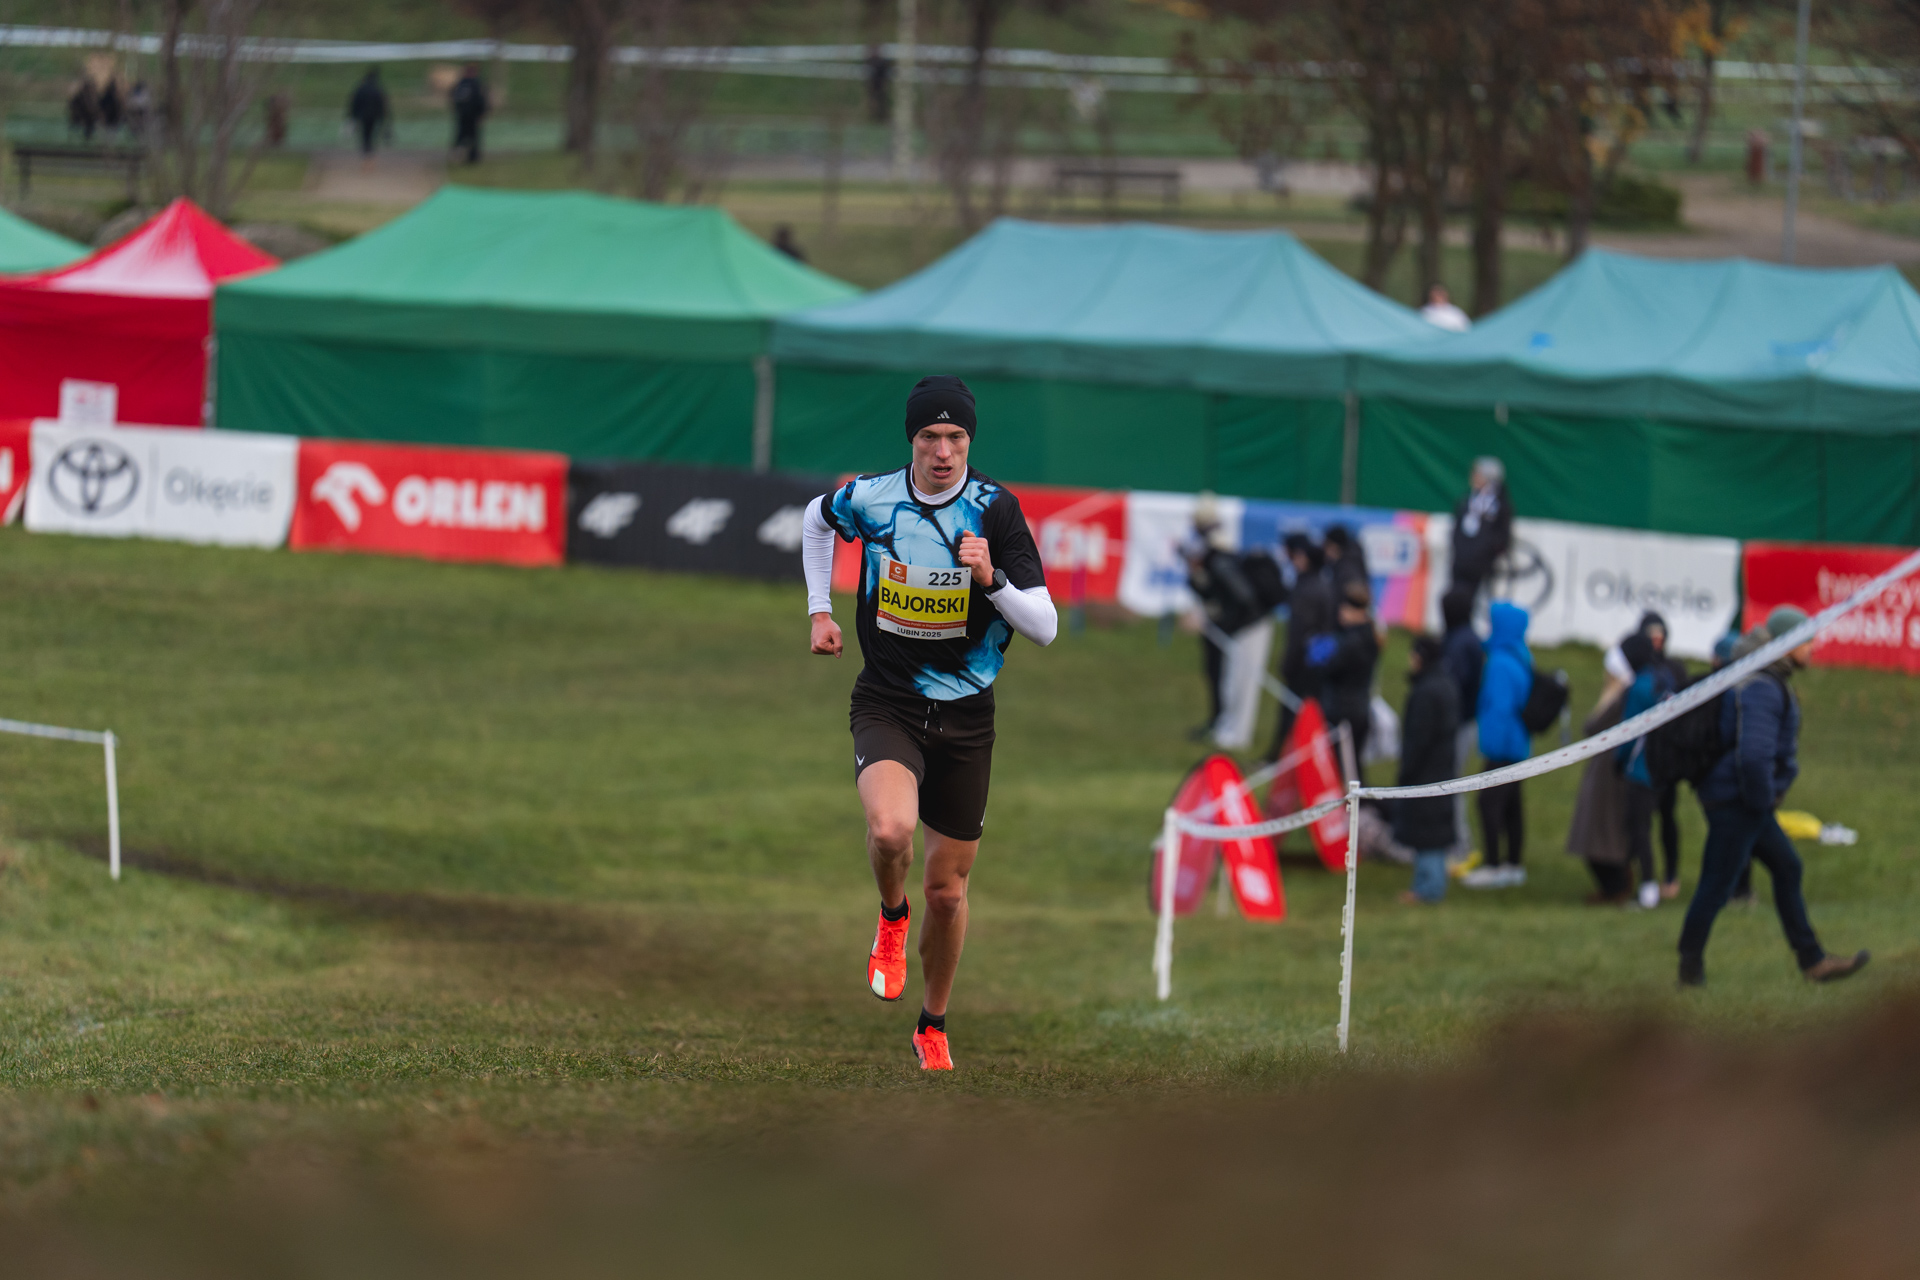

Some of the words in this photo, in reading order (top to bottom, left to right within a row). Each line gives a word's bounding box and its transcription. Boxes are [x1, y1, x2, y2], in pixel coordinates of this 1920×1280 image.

[392, 475, 547, 533] ORLEN
[928, 572, 962, 586] 225
[881, 586, 965, 614] BAJORSKI
[897, 627, 919, 637] LUBIN
